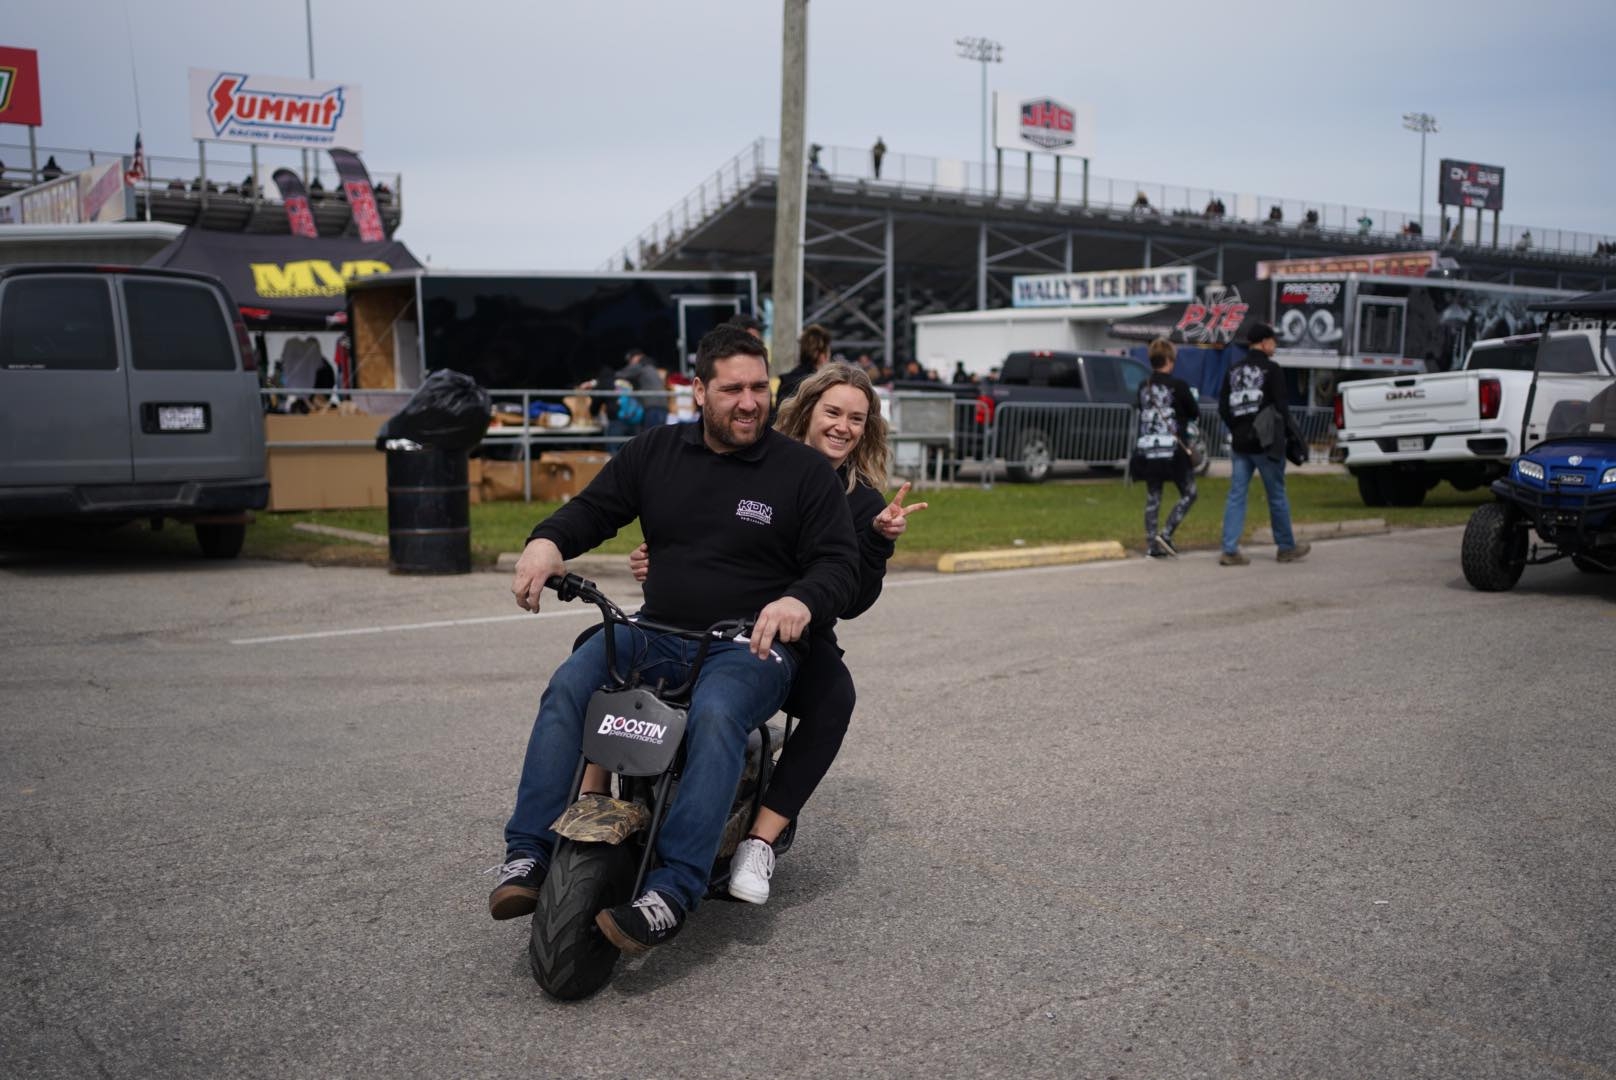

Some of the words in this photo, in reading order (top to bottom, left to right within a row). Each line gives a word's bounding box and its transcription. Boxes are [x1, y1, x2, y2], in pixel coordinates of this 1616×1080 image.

[1022, 103, 1073, 132] JHG
[1095, 276, 1120, 298] ICE
[1125, 272, 1187, 297] HOUSE
[1176, 303, 1249, 332] PTE
[1386, 389, 1426, 401] GMC
[738, 499, 773, 518] KDN
[597, 713, 667, 739] BOOSTIN
[609, 729, 664, 745] performance
